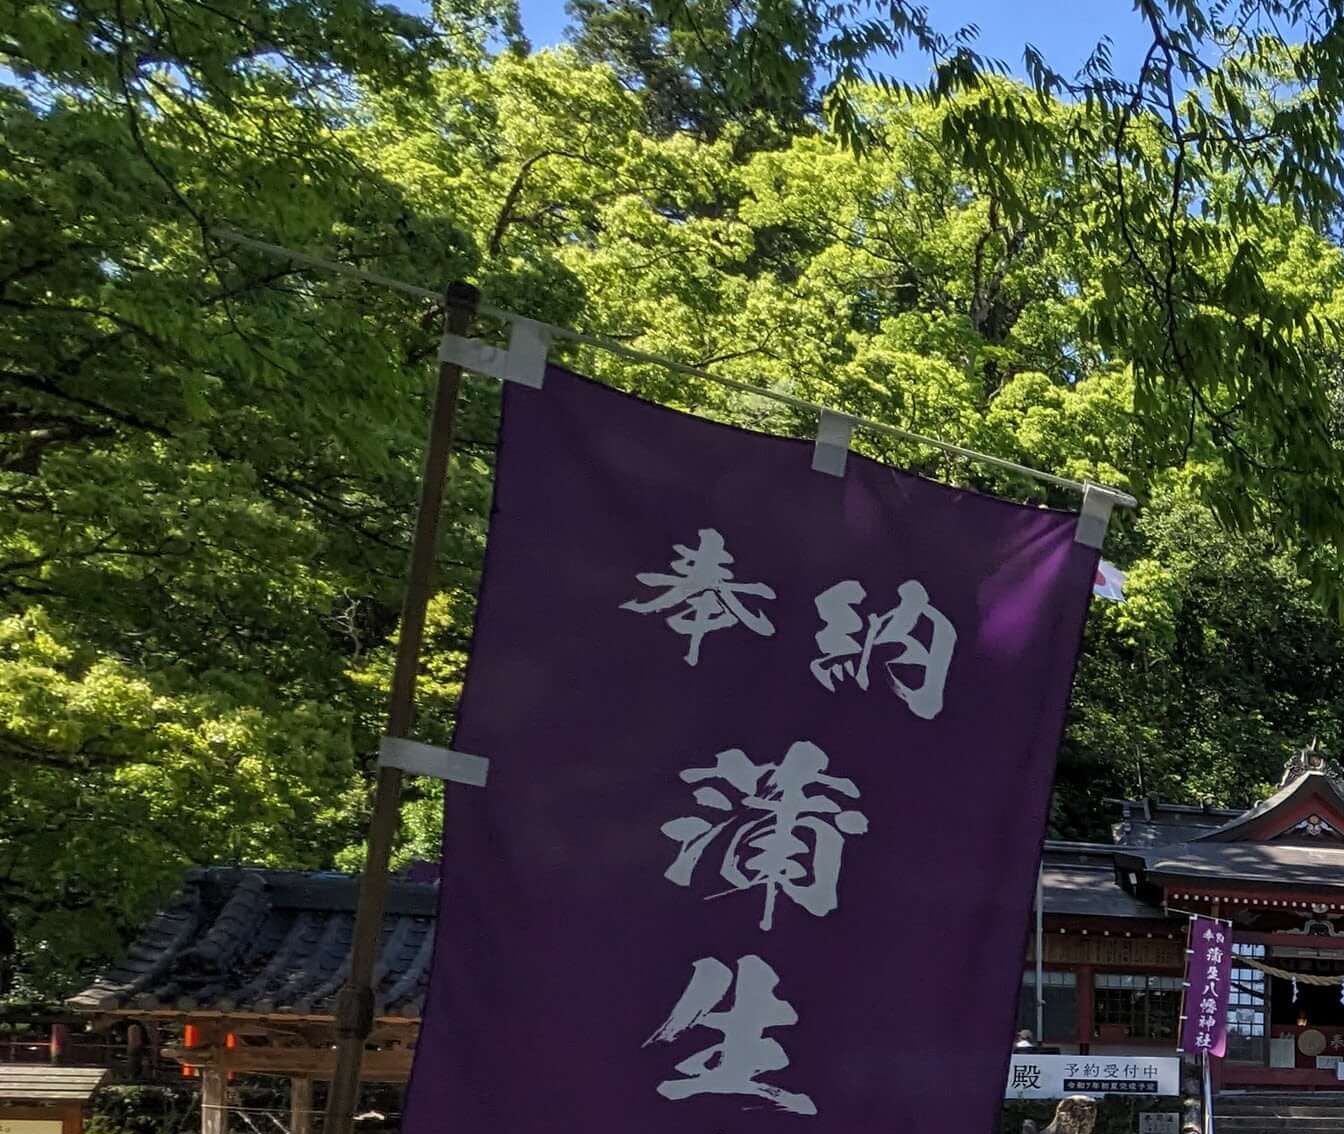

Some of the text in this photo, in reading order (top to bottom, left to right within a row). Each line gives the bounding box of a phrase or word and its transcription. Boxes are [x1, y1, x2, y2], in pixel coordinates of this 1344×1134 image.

[620, 529, 957, 719] 奉納
[1194, 947, 1223, 1048] 蒲生八幡神社
[1011, 1065, 1041, 1089] 殿
[1064, 1063, 1159, 1079] 予約受付中
